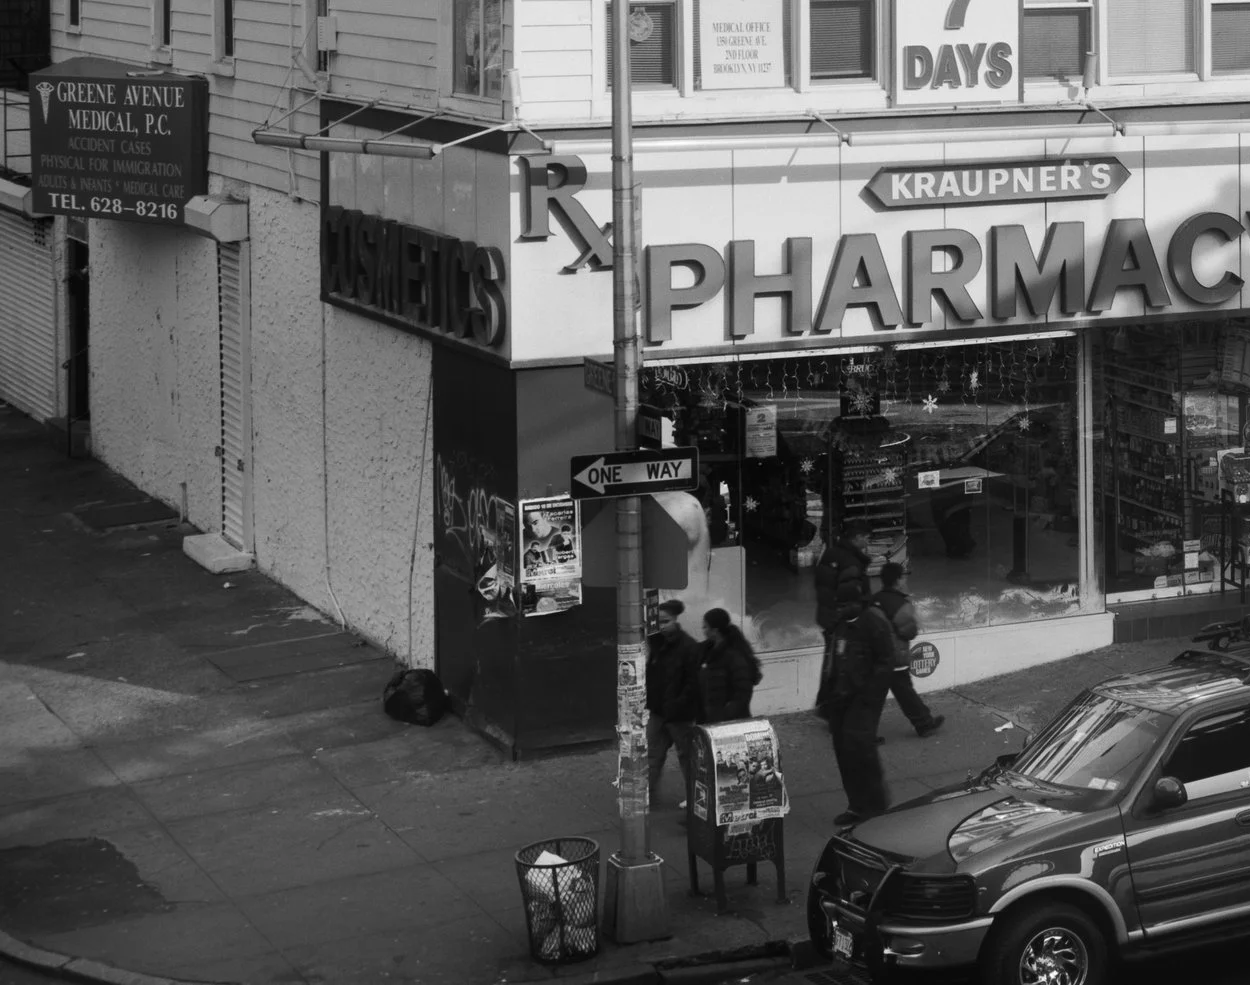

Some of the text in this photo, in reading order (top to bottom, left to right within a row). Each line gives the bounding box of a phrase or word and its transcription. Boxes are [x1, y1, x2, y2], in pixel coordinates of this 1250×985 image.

[712, 21, 771, 33] MEDICAL OFFICE
[738, 49, 759, 60] FLOOR
[902, 41, 1014, 90] DAYS
[57, 81, 185, 108] GREENE AVENUE
[68, 109, 172, 137] MEDICAL, P.C.
[68, 137, 152, 156] ACCIDENT CASES
[40, 154, 182, 177] PHYSICAL FOR IMMIGRATION
[37, 174, 185, 199] ADULTS & INFANTS MEDICAL CARE
[891, 162, 1112, 200] KRAUPNER'S
[48, 192, 178, 220] TEL. 628-8216
[588, 461, 682, 484] ONE WAY
